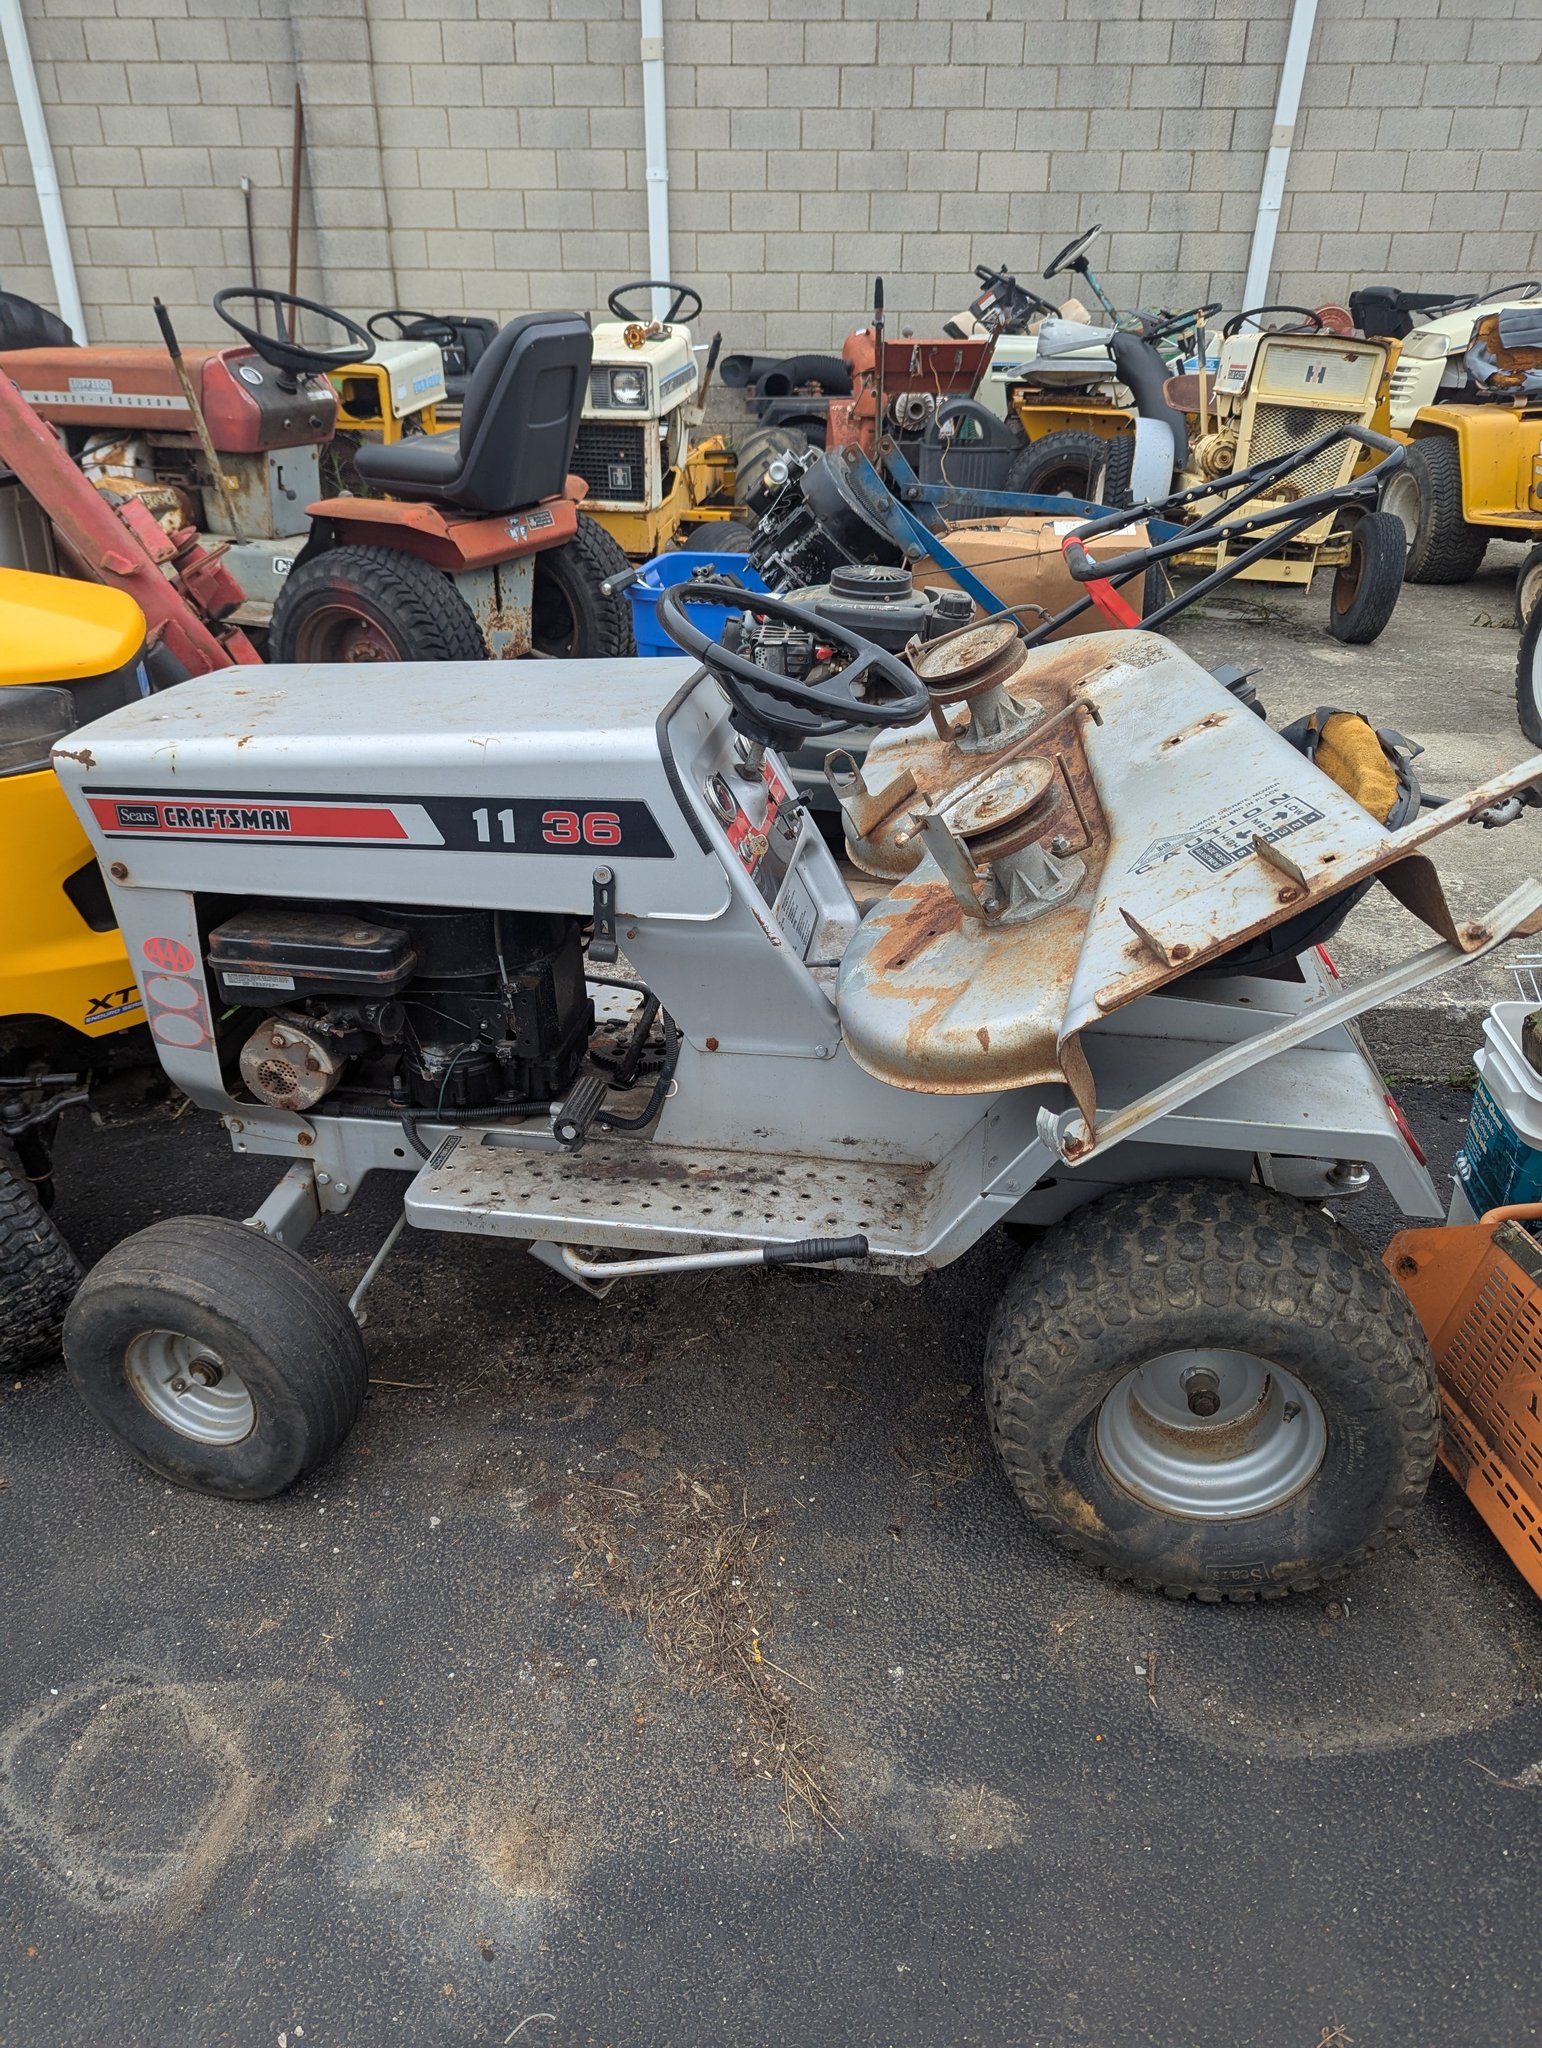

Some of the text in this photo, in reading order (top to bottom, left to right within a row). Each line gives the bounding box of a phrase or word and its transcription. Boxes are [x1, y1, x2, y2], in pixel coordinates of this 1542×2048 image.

[1252, 782, 1280, 797] MOWER
[1219, 806, 1243, 820] GUARD
[1255, 787, 1279, 802] PLACE
[1283, 802, 1306, 816] LOW
[120, 806, 622, 846] Sears CRAFTSMAN 11 36
[1251, 818, 1272, 832] MED
[1219, 834, 1241, 849] HIGH
[86, 1008, 120, 1023] ENDURO
[1212, 1567, 1262, 1582] Sears
